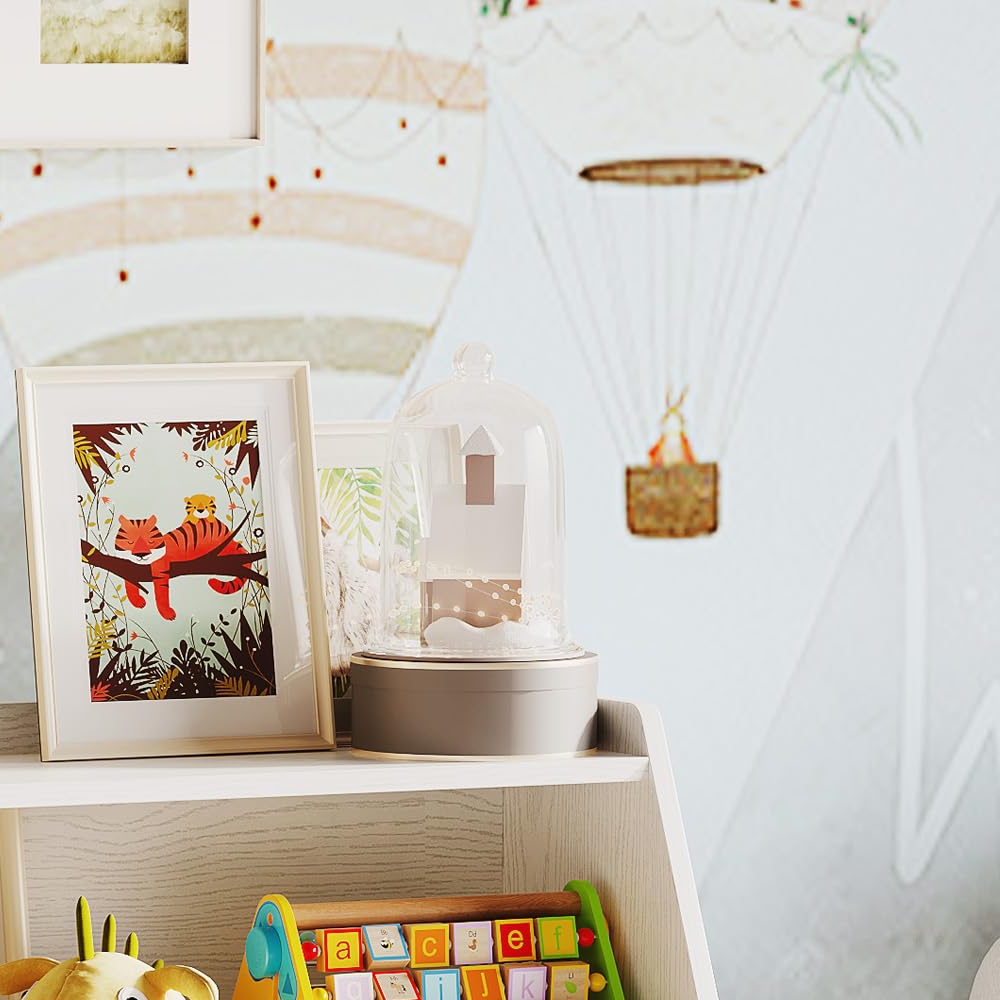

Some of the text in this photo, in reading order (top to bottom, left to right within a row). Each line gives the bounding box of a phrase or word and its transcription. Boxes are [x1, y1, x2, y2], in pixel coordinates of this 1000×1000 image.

[336, 926, 563, 960] a c Dd e f
[521, 974, 535, 999] k
